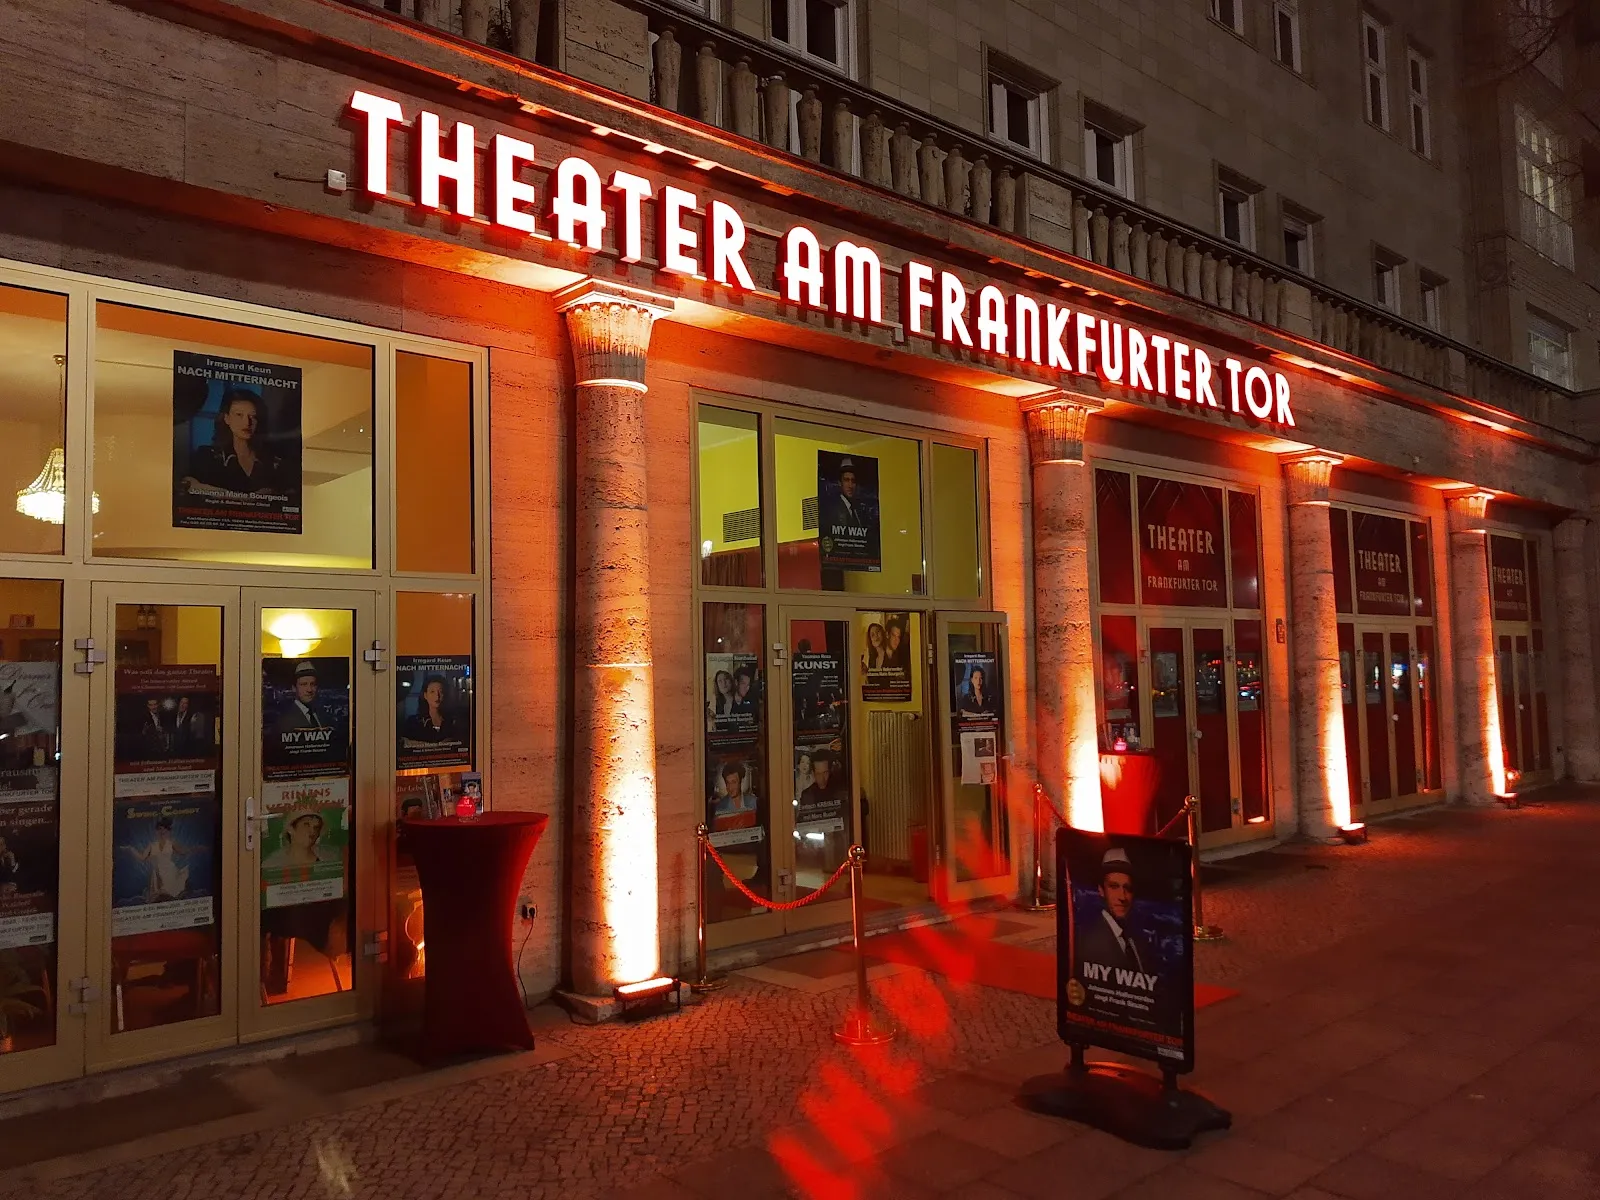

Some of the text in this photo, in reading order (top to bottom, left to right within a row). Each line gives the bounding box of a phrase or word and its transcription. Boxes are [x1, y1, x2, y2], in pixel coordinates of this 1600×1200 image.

[351, 90, 1296, 427] THEATER AM FRANKFURTER TOR
[206, 357, 272, 375] Irmgard Keun
[177, 365, 299, 389] NACH MITTERNACHT
[189, 487, 289, 502] Johanna Marie Bourgeois
[831, 524, 868, 537] MY WAY
[1147, 523, 1215, 556] THEATER
[1177, 559, 1190, 572] AM
[1357, 549, 1402, 574] THEATER
[1147, 575, 1218, 592] FRANKFURTER TOR
[1493, 565, 1524, 585] THEATER
[794, 661, 839, 670] KUNST
[281, 730, 333, 743] MY WAY
[18, 804, 53, 816] gerade
[1083, 961, 1159, 992] MY WAY
